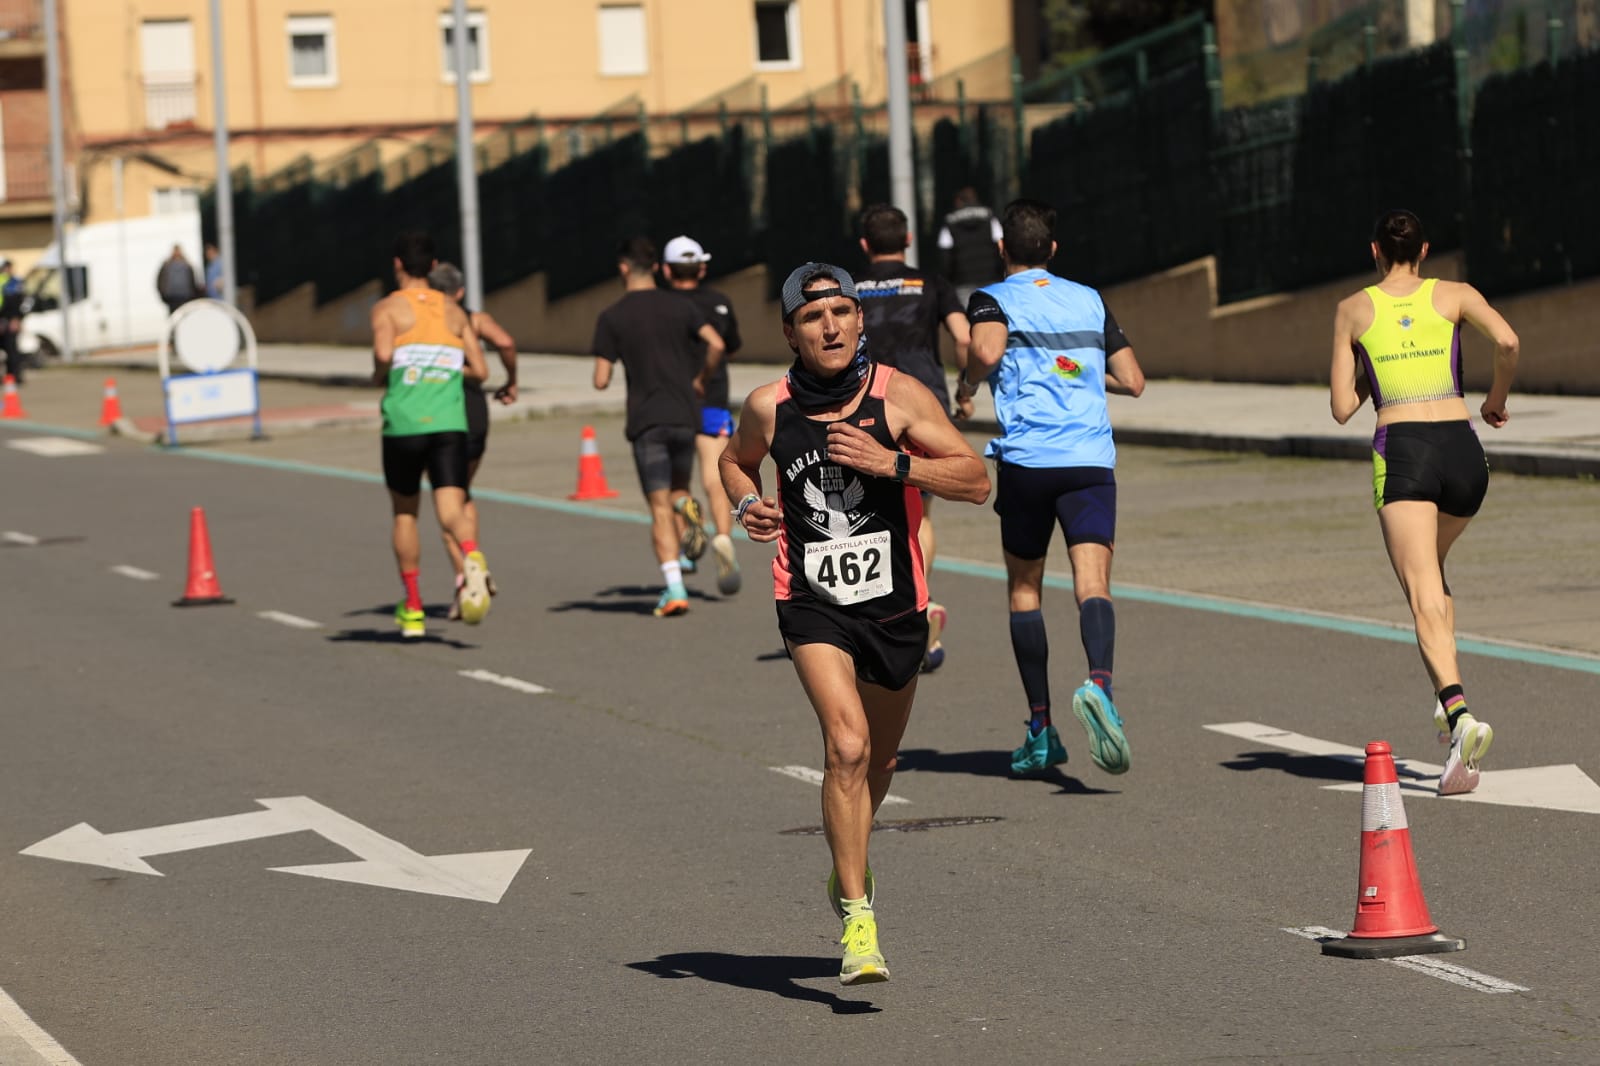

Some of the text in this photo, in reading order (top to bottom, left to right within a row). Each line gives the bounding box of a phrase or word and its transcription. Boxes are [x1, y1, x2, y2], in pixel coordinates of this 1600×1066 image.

[1400, 352, 1408, 360] DE
[786, 458, 805, 482] BAR
[805, 449, 820, 466] LA
[820, 466, 843, 479] RUN
[821, 479, 845, 492] CLUB
[812, 511, 826, 523] 20
[830, 541, 863, 550] CASTILLA
[817, 548, 881, 588] 462
